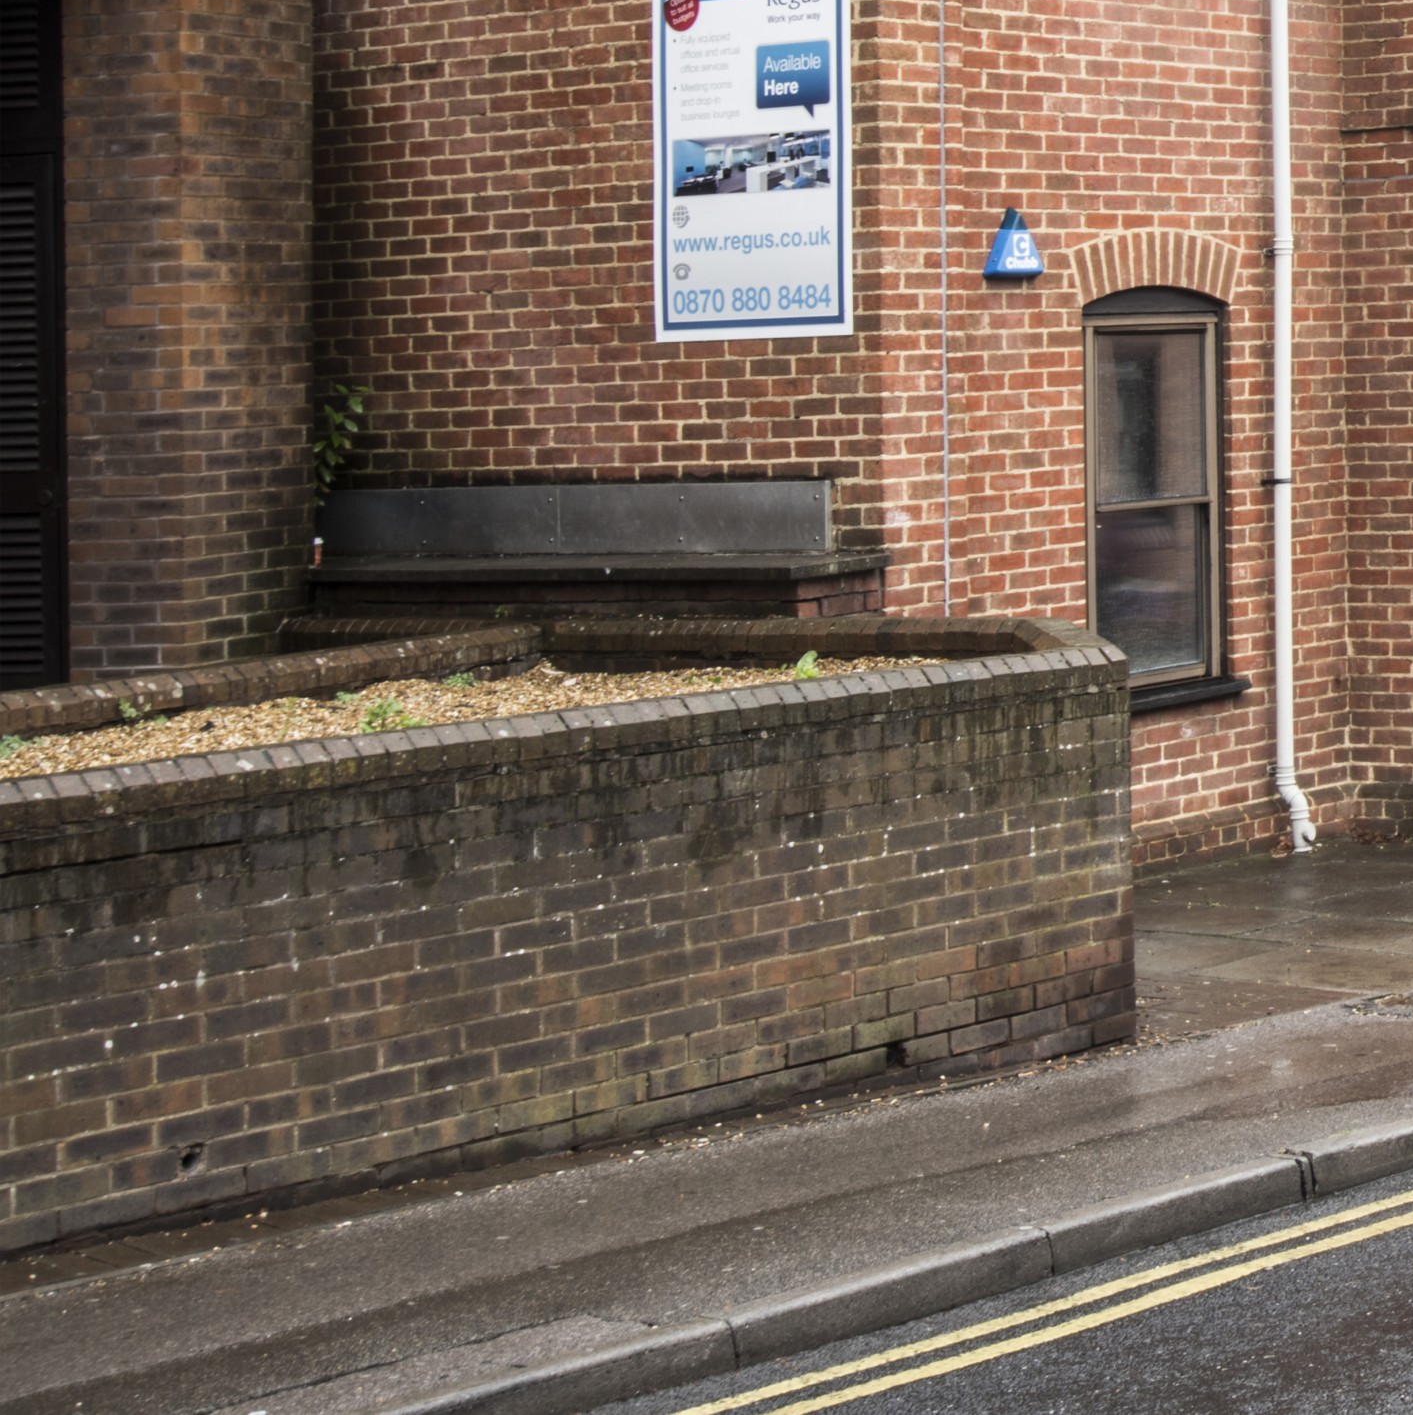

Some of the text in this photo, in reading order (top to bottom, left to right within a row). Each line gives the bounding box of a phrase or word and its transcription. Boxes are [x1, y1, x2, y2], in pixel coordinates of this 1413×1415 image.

[767, 12, 821, 24] Work your way
[697, 33, 731, 45] equipped
[680, 46, 740, 60] offices and virtual
[680, 62, 729, 74] office services
[763, 53, 821, 73] Available
[680, 81, 733, 93] Meeting rooms
[764, 79, 799, 96] Here
[680, 98, 694, 107] and
[680, 108, 740, 122] business lounges
[673, 226, 831, 254] www.regus.co.uk
[1005, 256, 1039, 269] Chubb
[673, 284, 831, 315] 0870 880 8484
